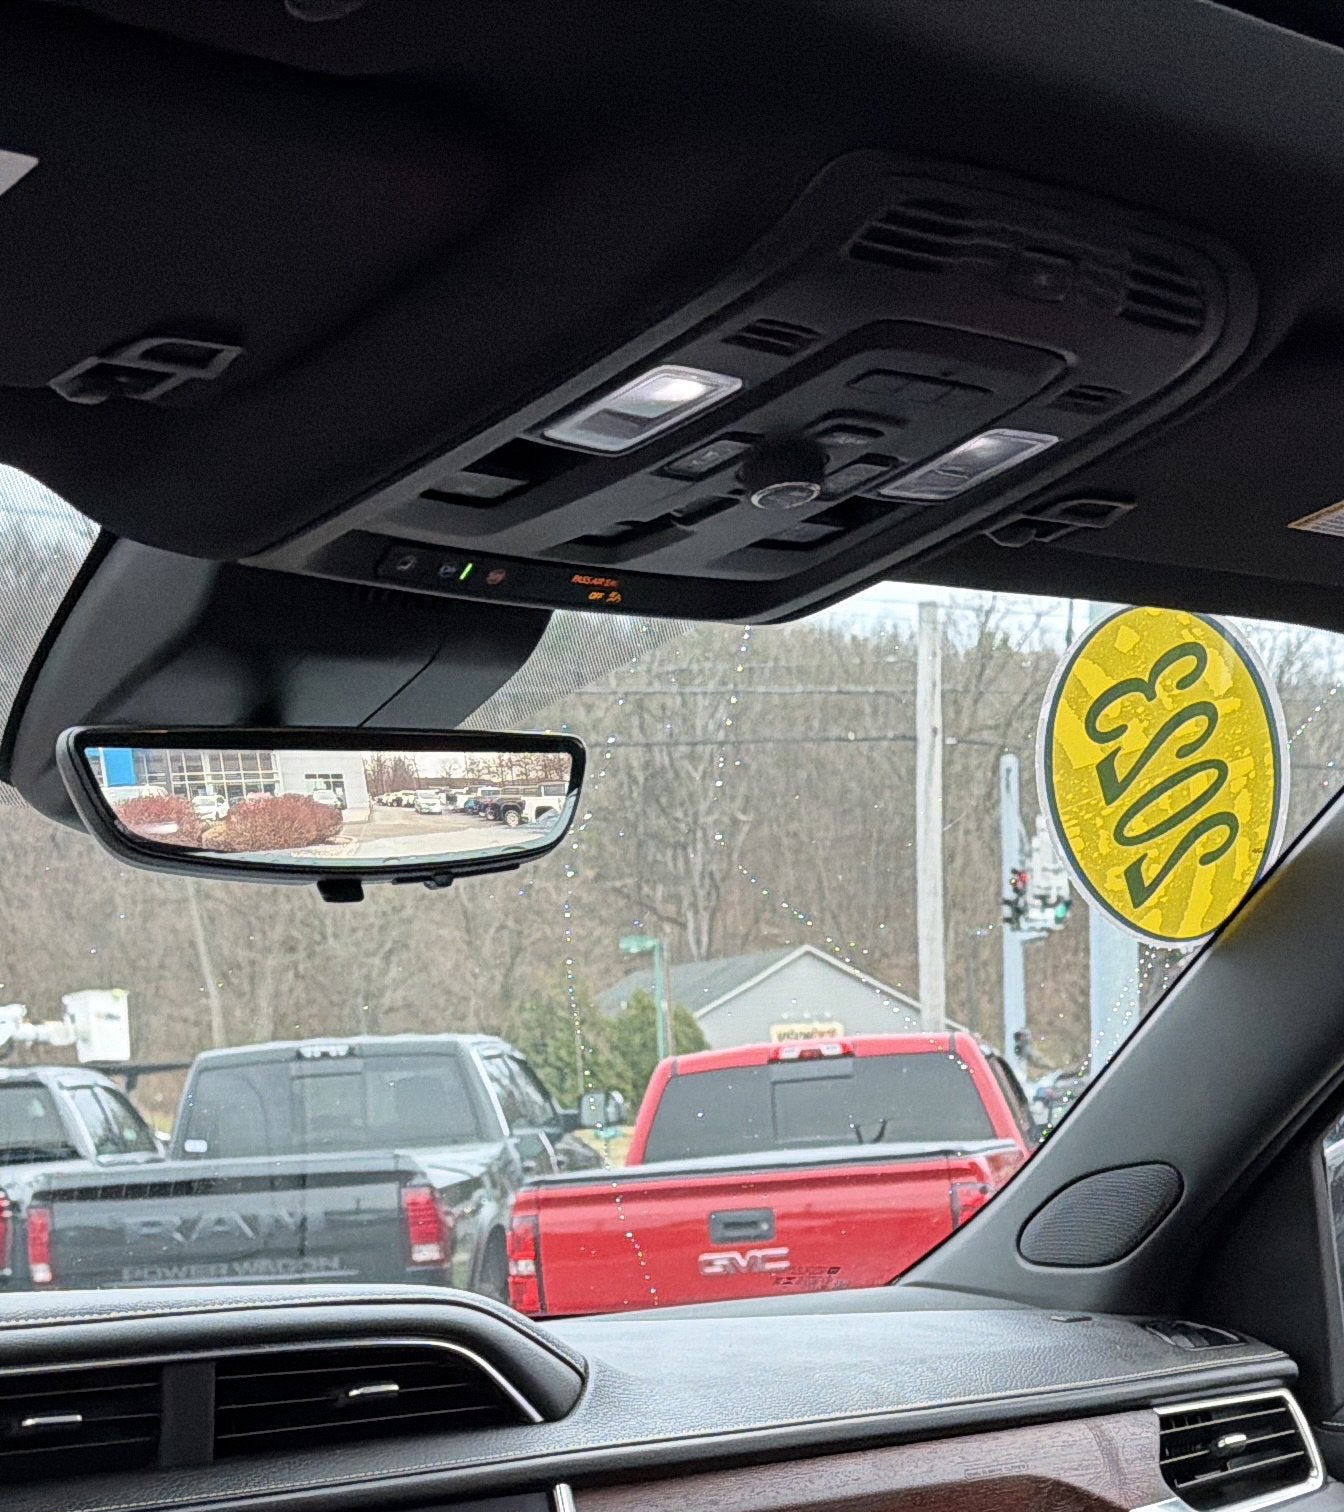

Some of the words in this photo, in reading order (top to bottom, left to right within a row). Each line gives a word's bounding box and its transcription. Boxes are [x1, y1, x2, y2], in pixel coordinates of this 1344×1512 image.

[122, 1207, 326, 1247] RAM
[122, 1264, 230, 1283] POWER
[698, 1246, 791, 1276] GMC
